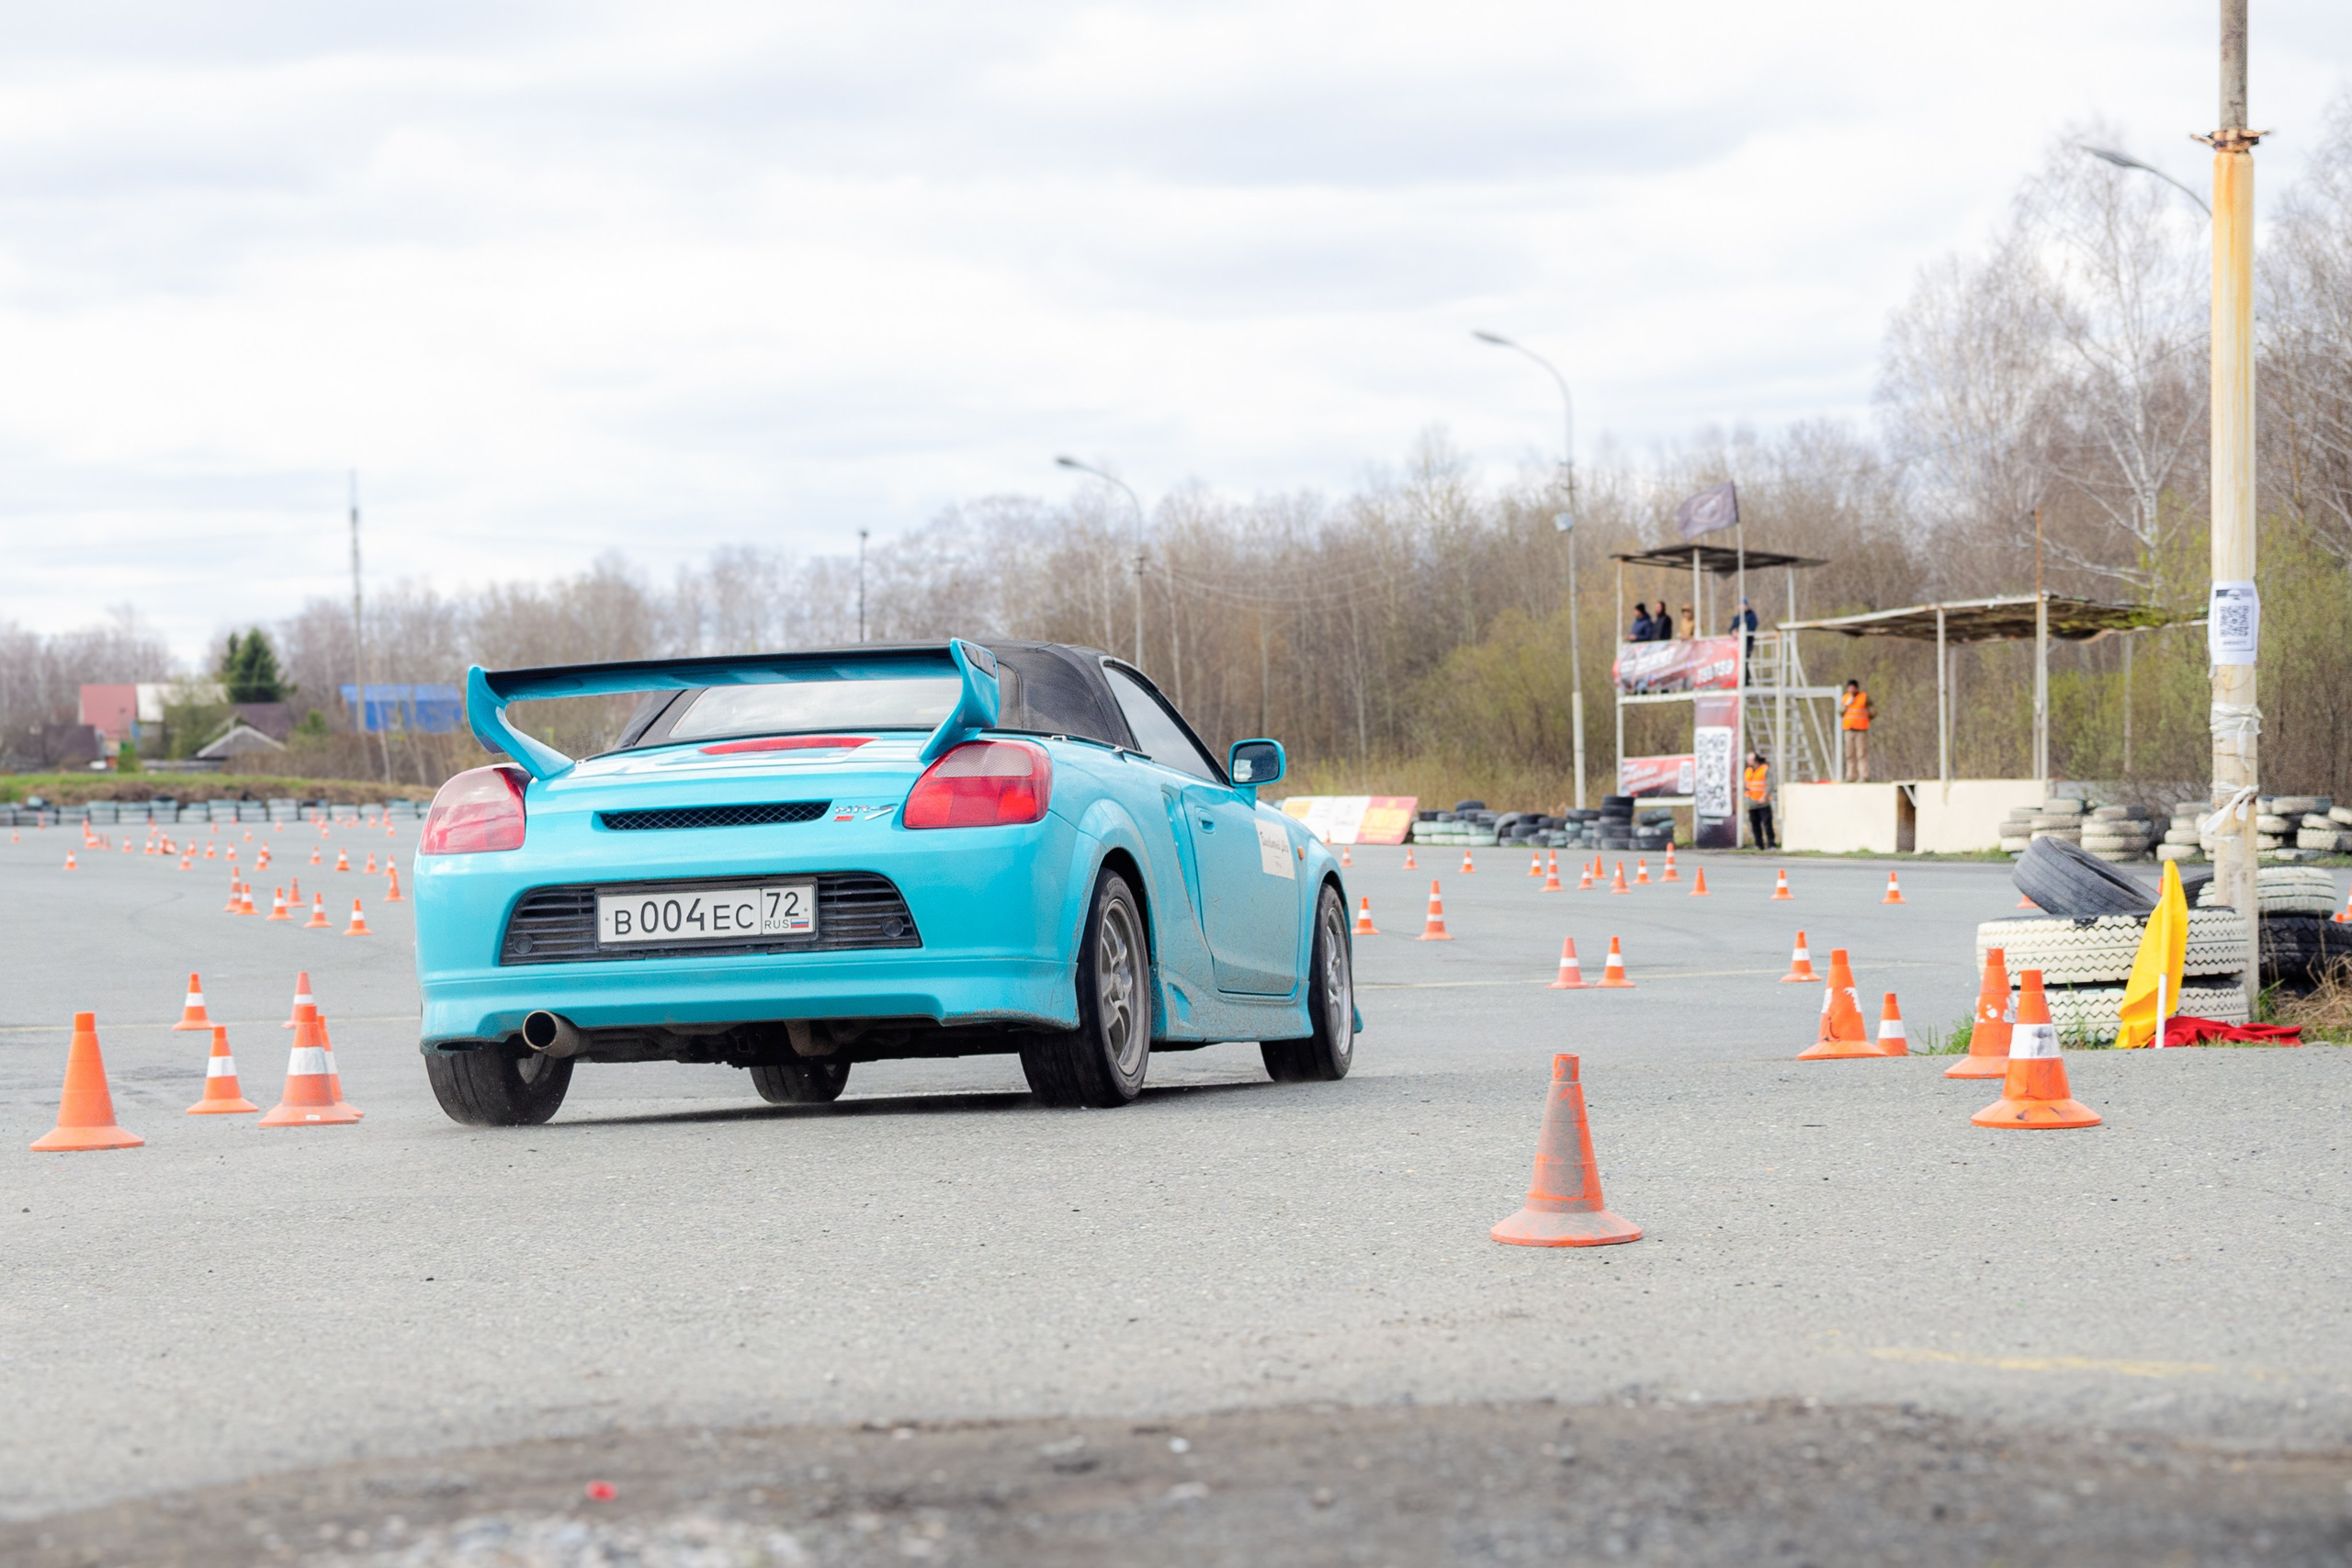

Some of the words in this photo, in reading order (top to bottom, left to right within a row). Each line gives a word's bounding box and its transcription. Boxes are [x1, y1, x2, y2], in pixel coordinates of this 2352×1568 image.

[834, 803, 899, 821] MR-S
[765, 891, 799, 919] 72
[764, 919, 789, 930] RUS
